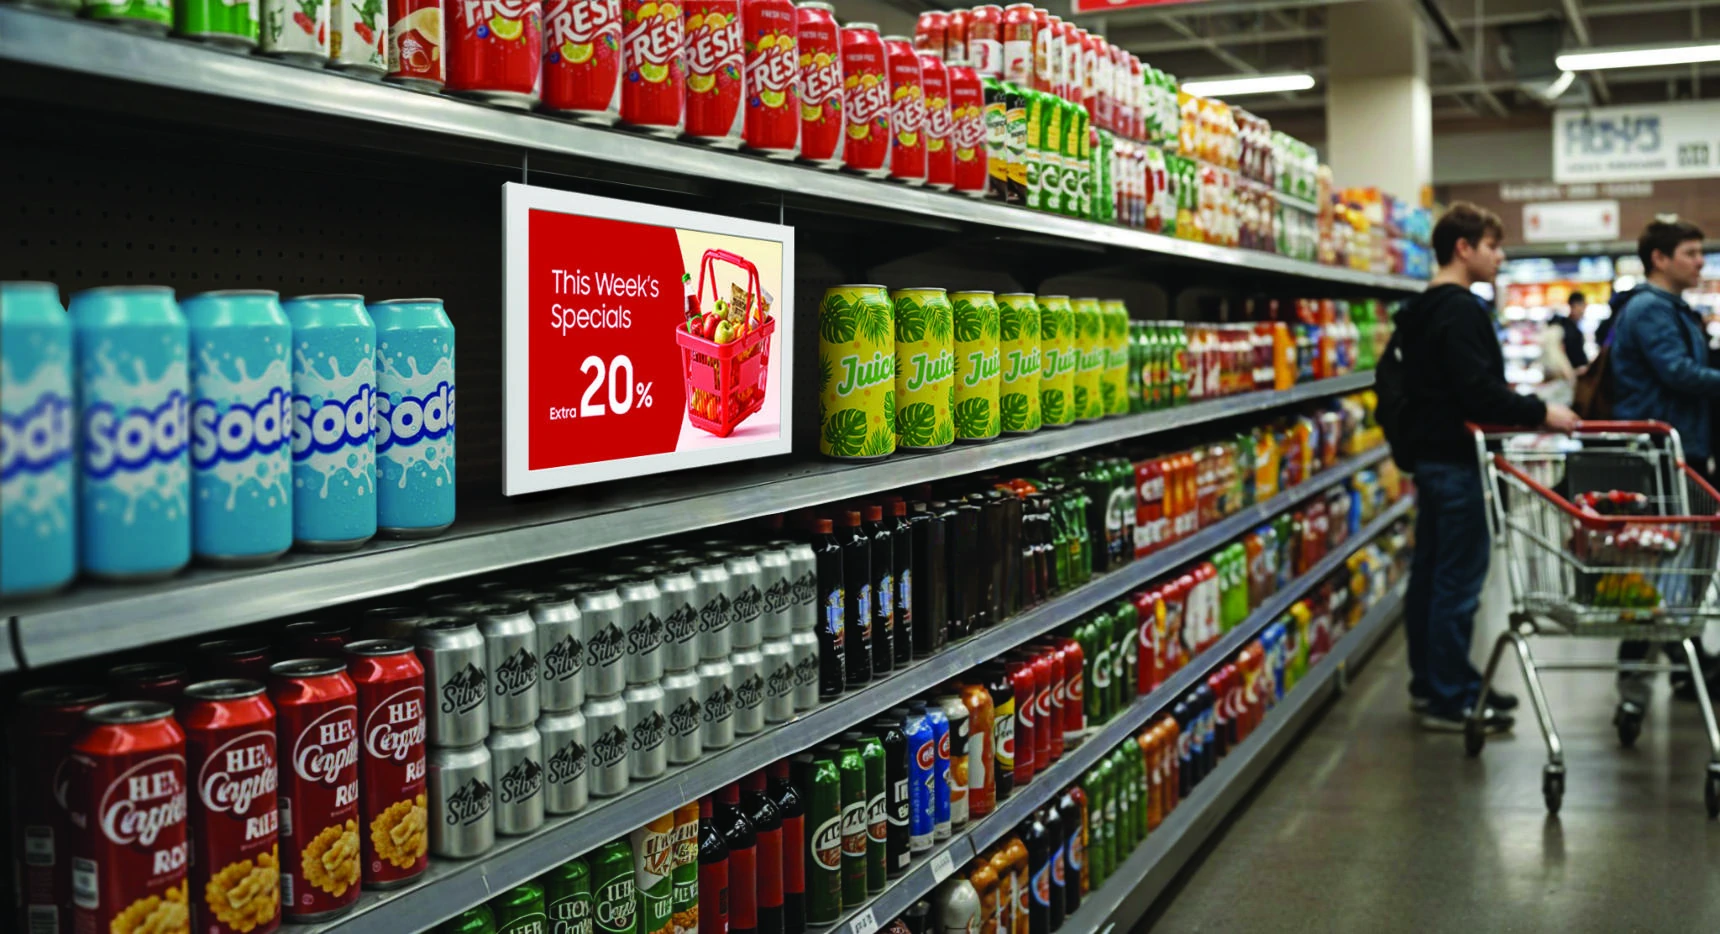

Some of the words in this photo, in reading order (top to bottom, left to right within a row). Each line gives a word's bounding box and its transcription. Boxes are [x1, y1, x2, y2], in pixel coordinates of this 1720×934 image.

[551, 268, 591, 296] This
[595, 271, 660, 298] Week's
[551, 303, 632, 336] Specials
[907, 349, 954, 391] Juic
[550, 406, 576, 420] Extra
